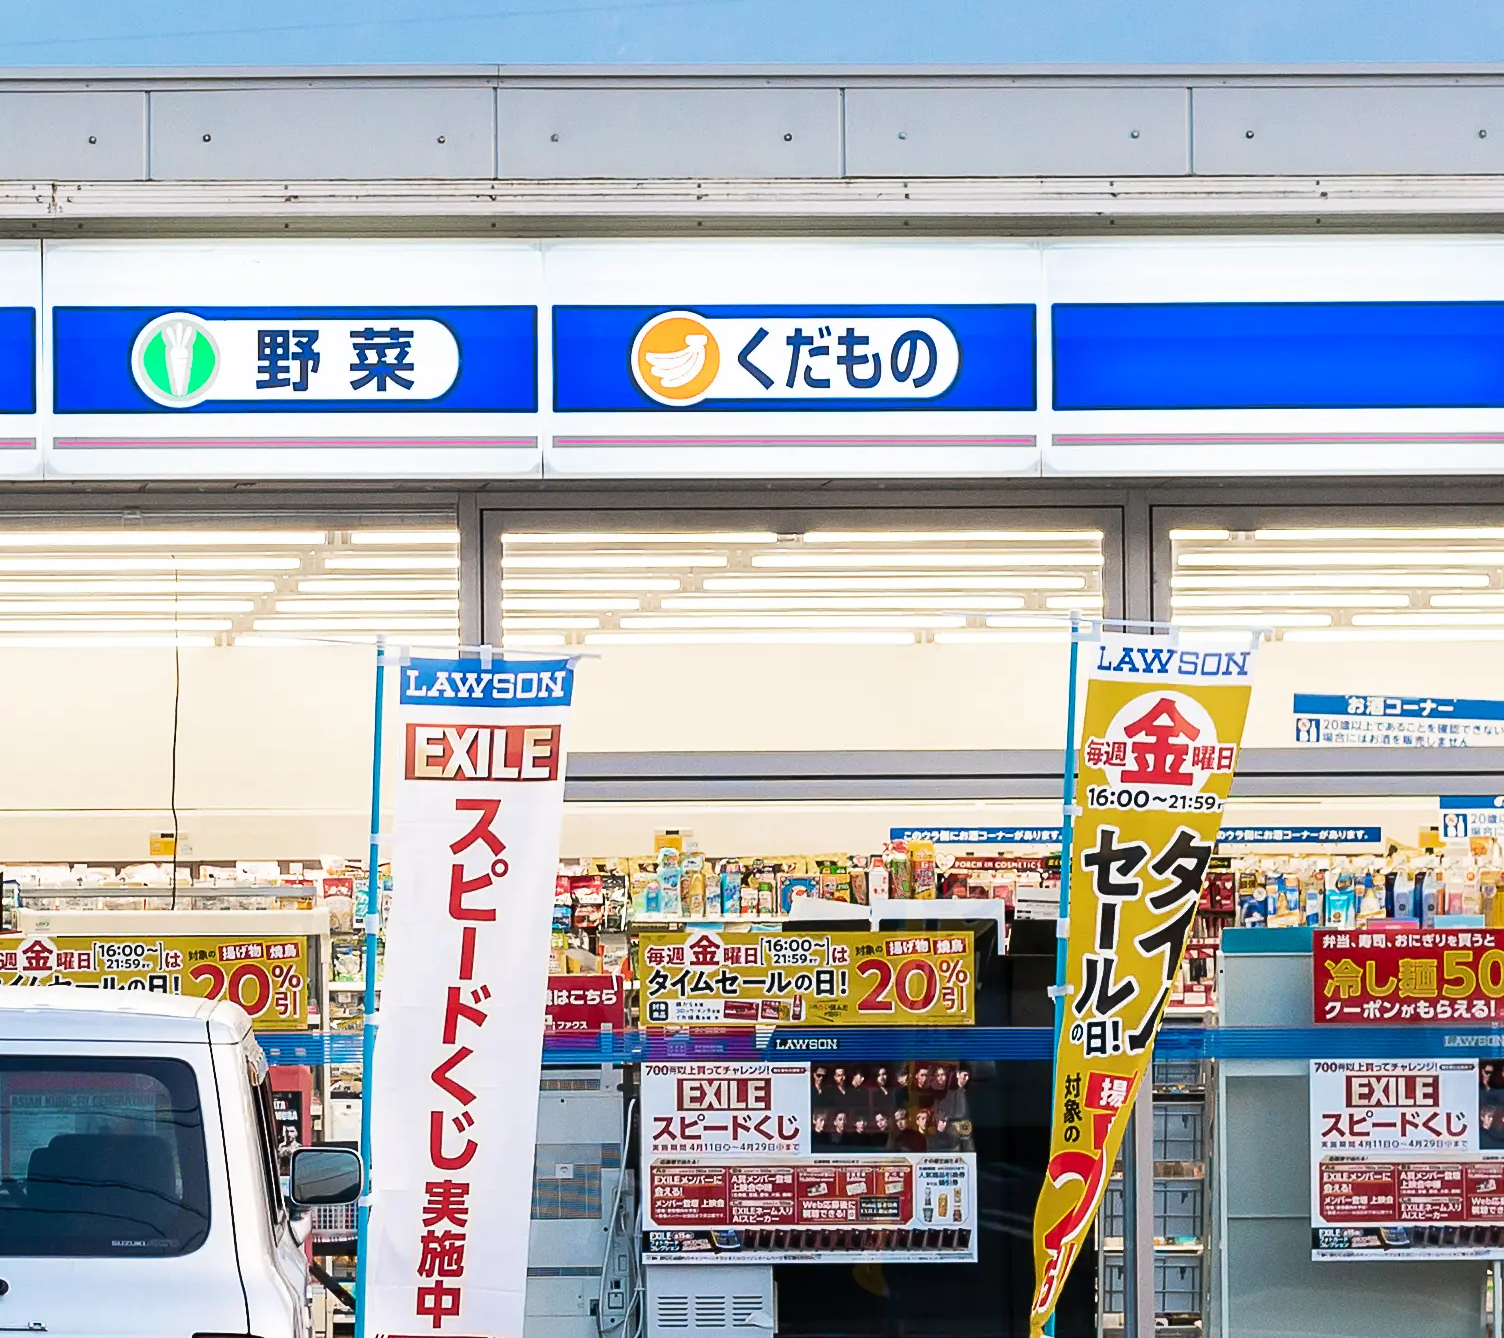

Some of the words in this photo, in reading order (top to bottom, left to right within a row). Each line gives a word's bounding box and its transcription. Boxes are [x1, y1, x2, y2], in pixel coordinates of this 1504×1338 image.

[254, 327, 416, 392] 野菜
[735, 325, 938, 390] くだもの
[1096, 645, 1252, 677] LAWSON
[404, 668, 567, 700] LAWSON
[414, 726, 553, 780] EXILE
[646, 934, 759, 966] 毎週金曜日
[647, 968, 848, 996] タイムセールの日!
[1324, 1000, 1497, 1020] クーポンがもらえる!
[775, 1038, 838, 1050] LAWSON
[682, 1080, 766, 1109] EXILE
[1351, 1077, 1434, 1106] EXILE
[1063, 1072, 1083, 1144] 対象の
[652, 1113, 800, 1141] スピードくじ
[1321, 1109, 1468, 1138] スピードくじ
